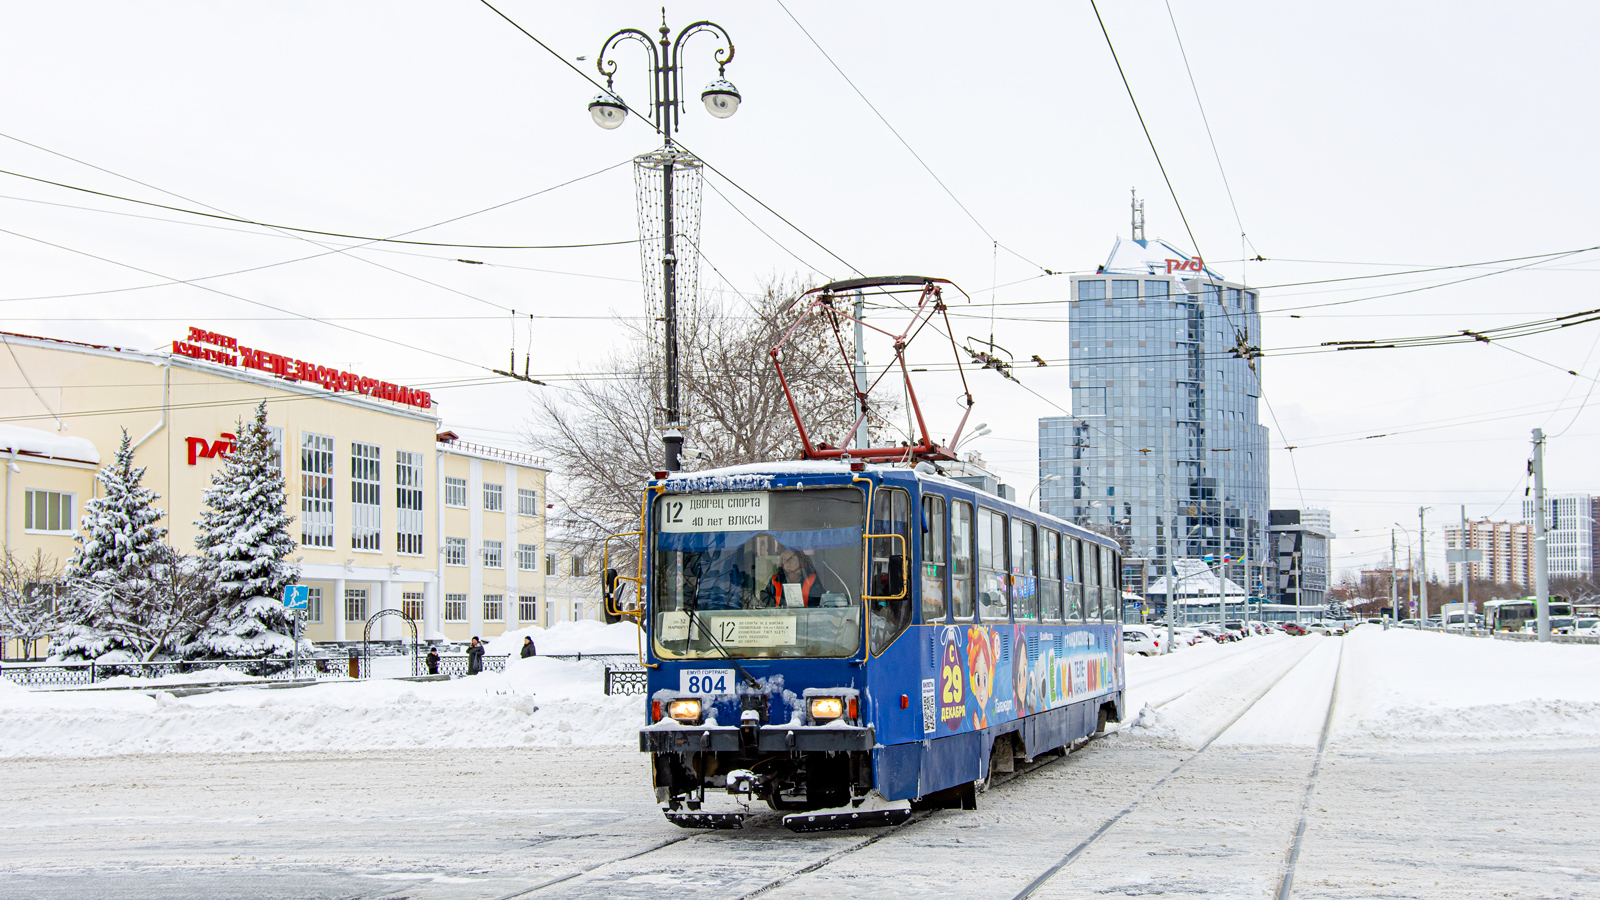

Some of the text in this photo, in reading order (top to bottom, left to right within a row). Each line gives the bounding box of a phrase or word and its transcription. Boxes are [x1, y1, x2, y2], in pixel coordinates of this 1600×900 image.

[1165, 256, 1203, 274] РЖД
[187, 326, 237, 353] ДВОРЕЦ
[172, 340, 237, 367] КУЛЬТУРЫ
[238, 345, 431, 409] ЖЕЛЕЗНОДОРОЖНИКОВ
[666, 502, 683, 523] 12
[690, 497, 760, 510] ДВОРЕЦ СПОРТА
[692, 517, 703, 526] 40
[728, 515, 763, 526] ВЛКСМ
[719, 621, 736, 642] 12
[949, 644, 955, 663] С
[688, 675, 727, 694] 804
[943, 665, 962, 704] 29
[941, 705, 966, 722] ДЕКАБРЯ
